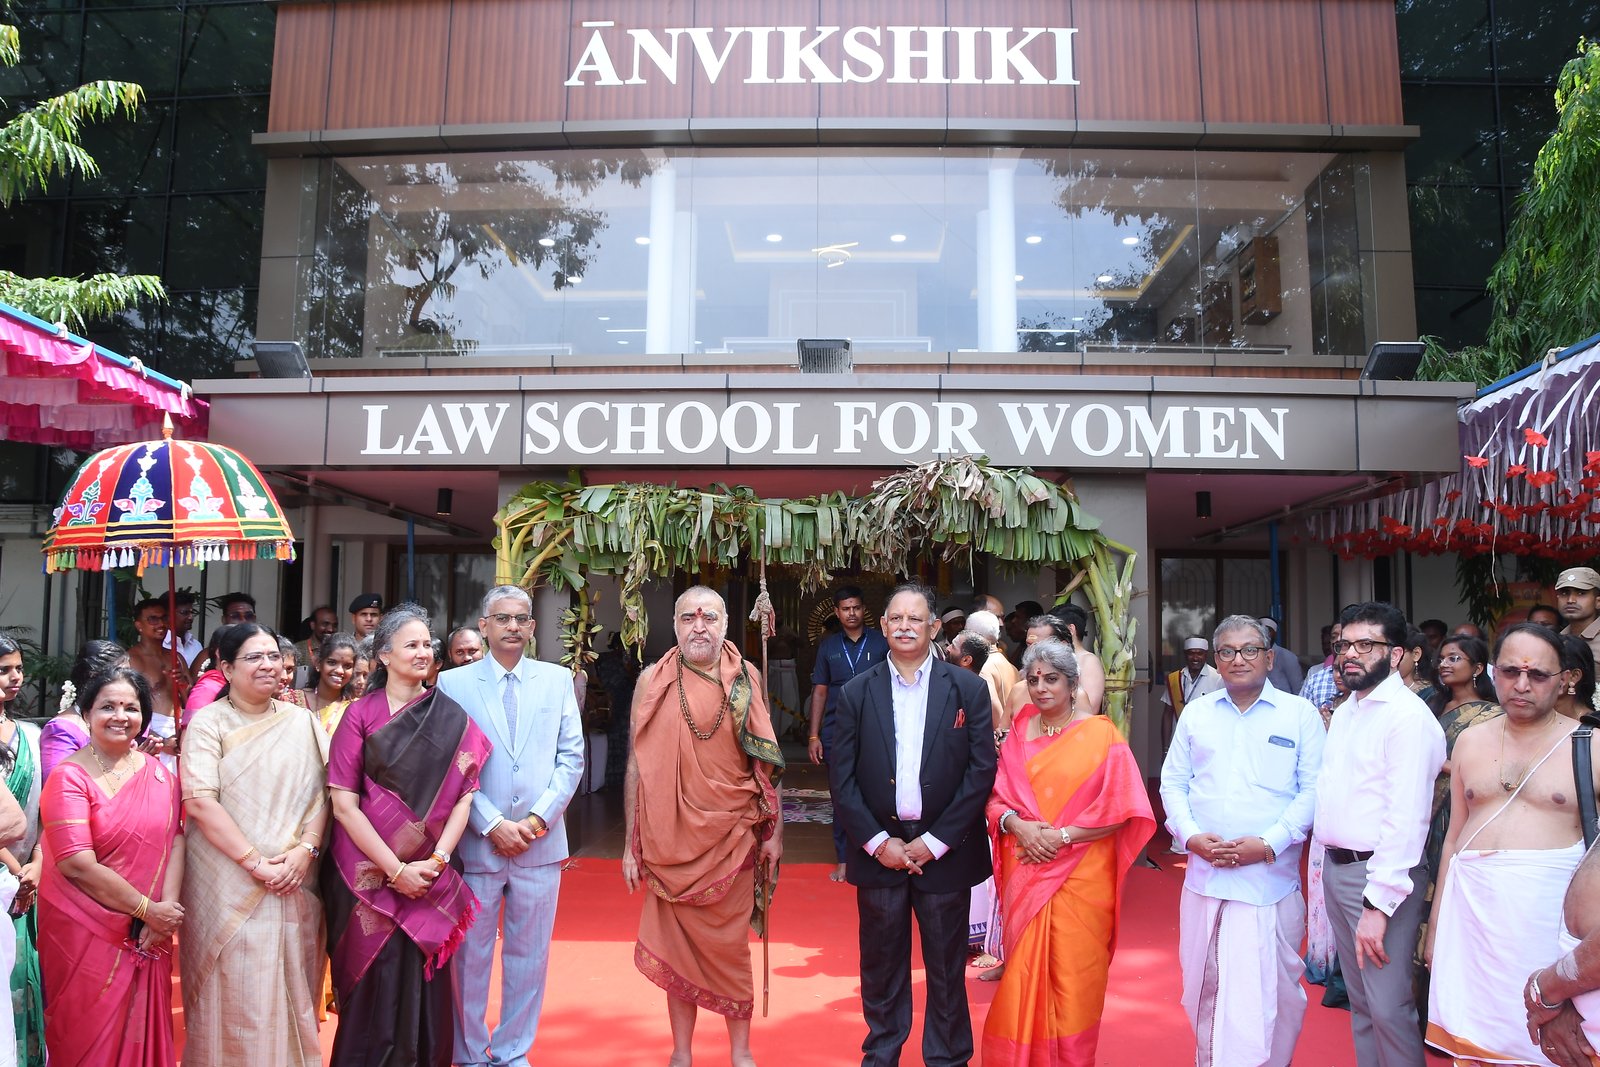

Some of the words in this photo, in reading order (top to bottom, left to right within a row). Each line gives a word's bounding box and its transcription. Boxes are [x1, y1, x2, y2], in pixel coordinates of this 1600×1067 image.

[360, 402, 511, 456] LAW
[524, 400, 819, 456] SCHOOL
[833, 400, 986, 455] FOR
[998, 402, 1290, 461] WOMEN
